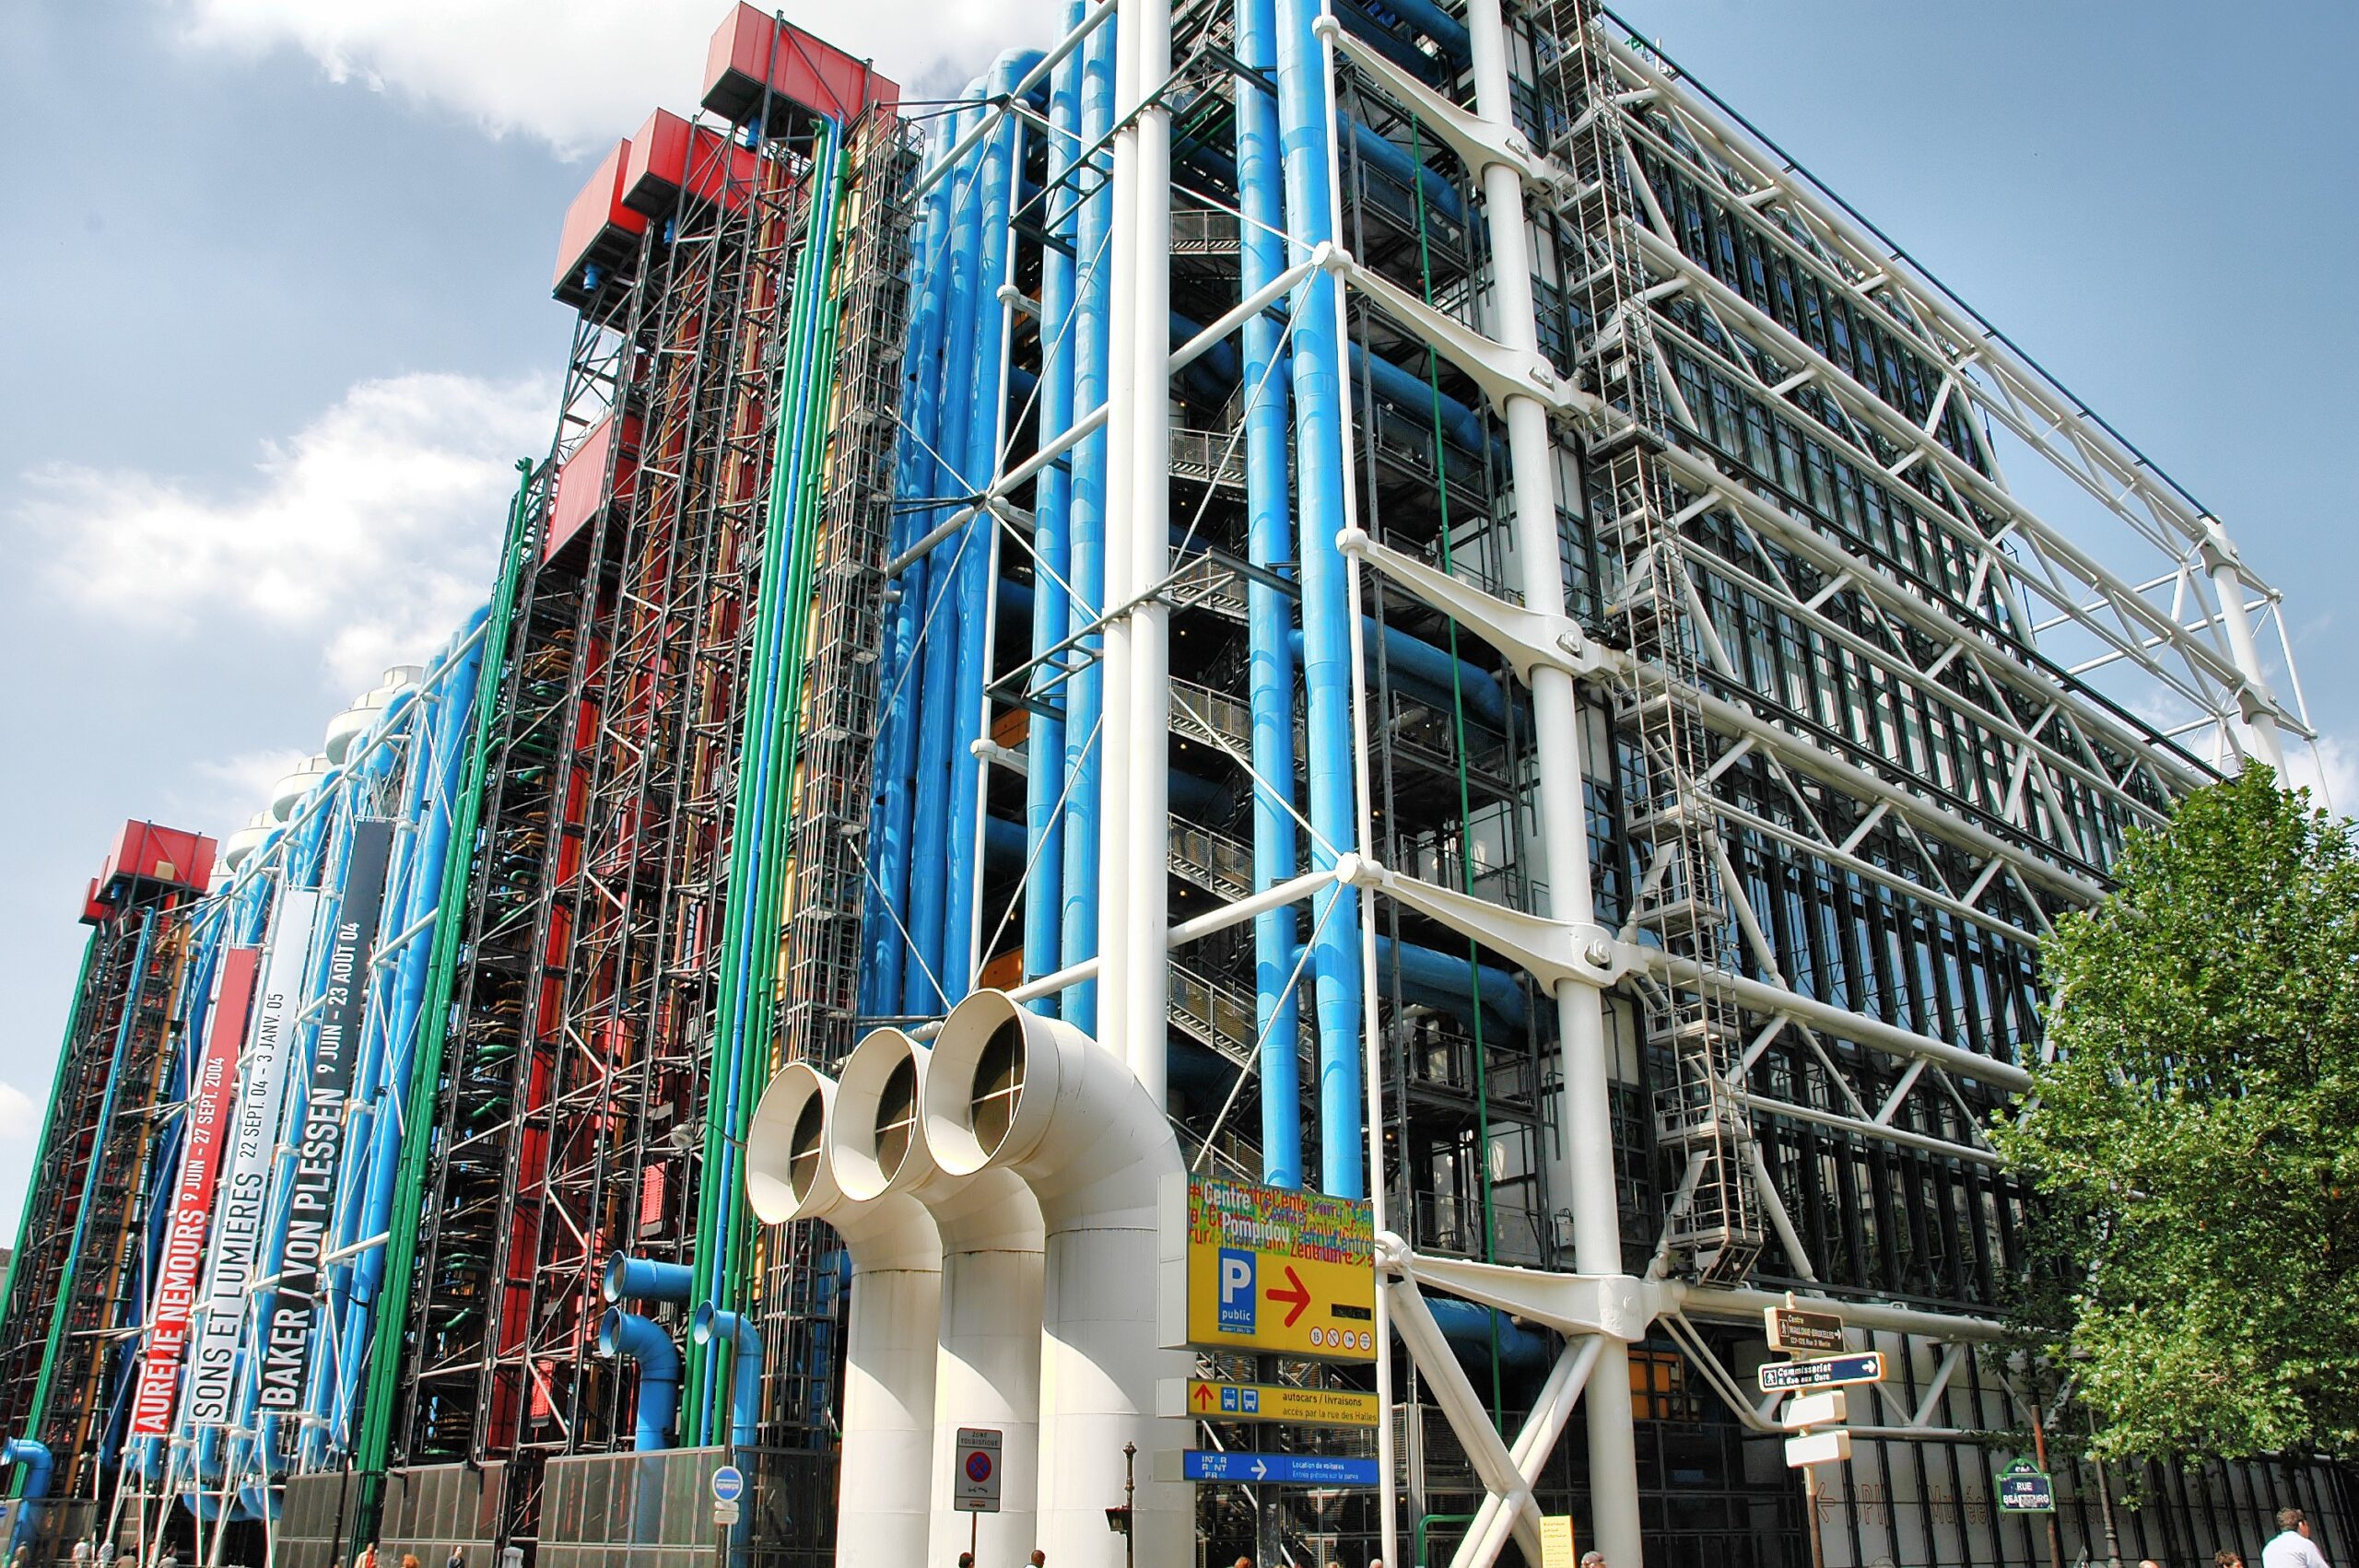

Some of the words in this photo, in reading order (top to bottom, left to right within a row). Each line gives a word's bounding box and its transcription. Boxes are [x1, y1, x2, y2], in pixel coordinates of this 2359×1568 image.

[338, 921, 361, 942] 04
[266, 993, 284, 1011] 05
[327, 987, 349, 1006] 23
[259, 1013, 282, 1051] JANV.
[318, 1024, 343, 1060] JUIN
[257, 1054, 273, 1063] 3
[316, 1064, 337, 1073] 9
[204, 1057, 225, 1087] 2004
[251, 1081, 269, 1097] 04
[197, 1091, 219, 1125] SEPT.
[243, 1101, 265, 1138] SEPT.
[193, 1128, 211, 1145] 27
[240, 1141, 258, 1159] 22
[294, 1087, 346, 1211] PLESSEN
[184, 1159, 205, 1189] JUIN
[182, 1192, 199, 1202] 9
[1204, 1181, 1250, 1211] Centre
[1222, 1211, 1289, 1245] Pompidou
[281, 1219, 325, 1278] VON
[159, 1210, 205, 1321] NEMOURS
[1222, 1258, 1251, 1304] P
[278, 1288, 316, 1300] /
[207, 1309, 240, 1338] ET
[1222, 1308, 1251, 1321] public
[261, 1308, 311, 1407] BAKER
[137, 1329, 184, 1432] AURELIE
[1777, 1363, 1833, 1377] Commissariat
[193, 1348, 233, 1419] SONS
[1283, 1392, 1318, 1404] autocars
[1324, 1394, 1363, 1407] livraisons
[1283, 1407, 1303, 1416] accès
[1305, 1410, 1317, 1419] par
[1319, 1410, 1326, 1418] la
[1327, 1410, 1340, 1419] rue
[1341, 1410, 1354, 1420] des
[1355, 1411, 1377, 1422] Halles
[960, 1437, 998, 1446] TOURISTIQUE
[1292, 1460, 1315, 1469] Location
[2016, 1481, 2033, 1492] RUE
